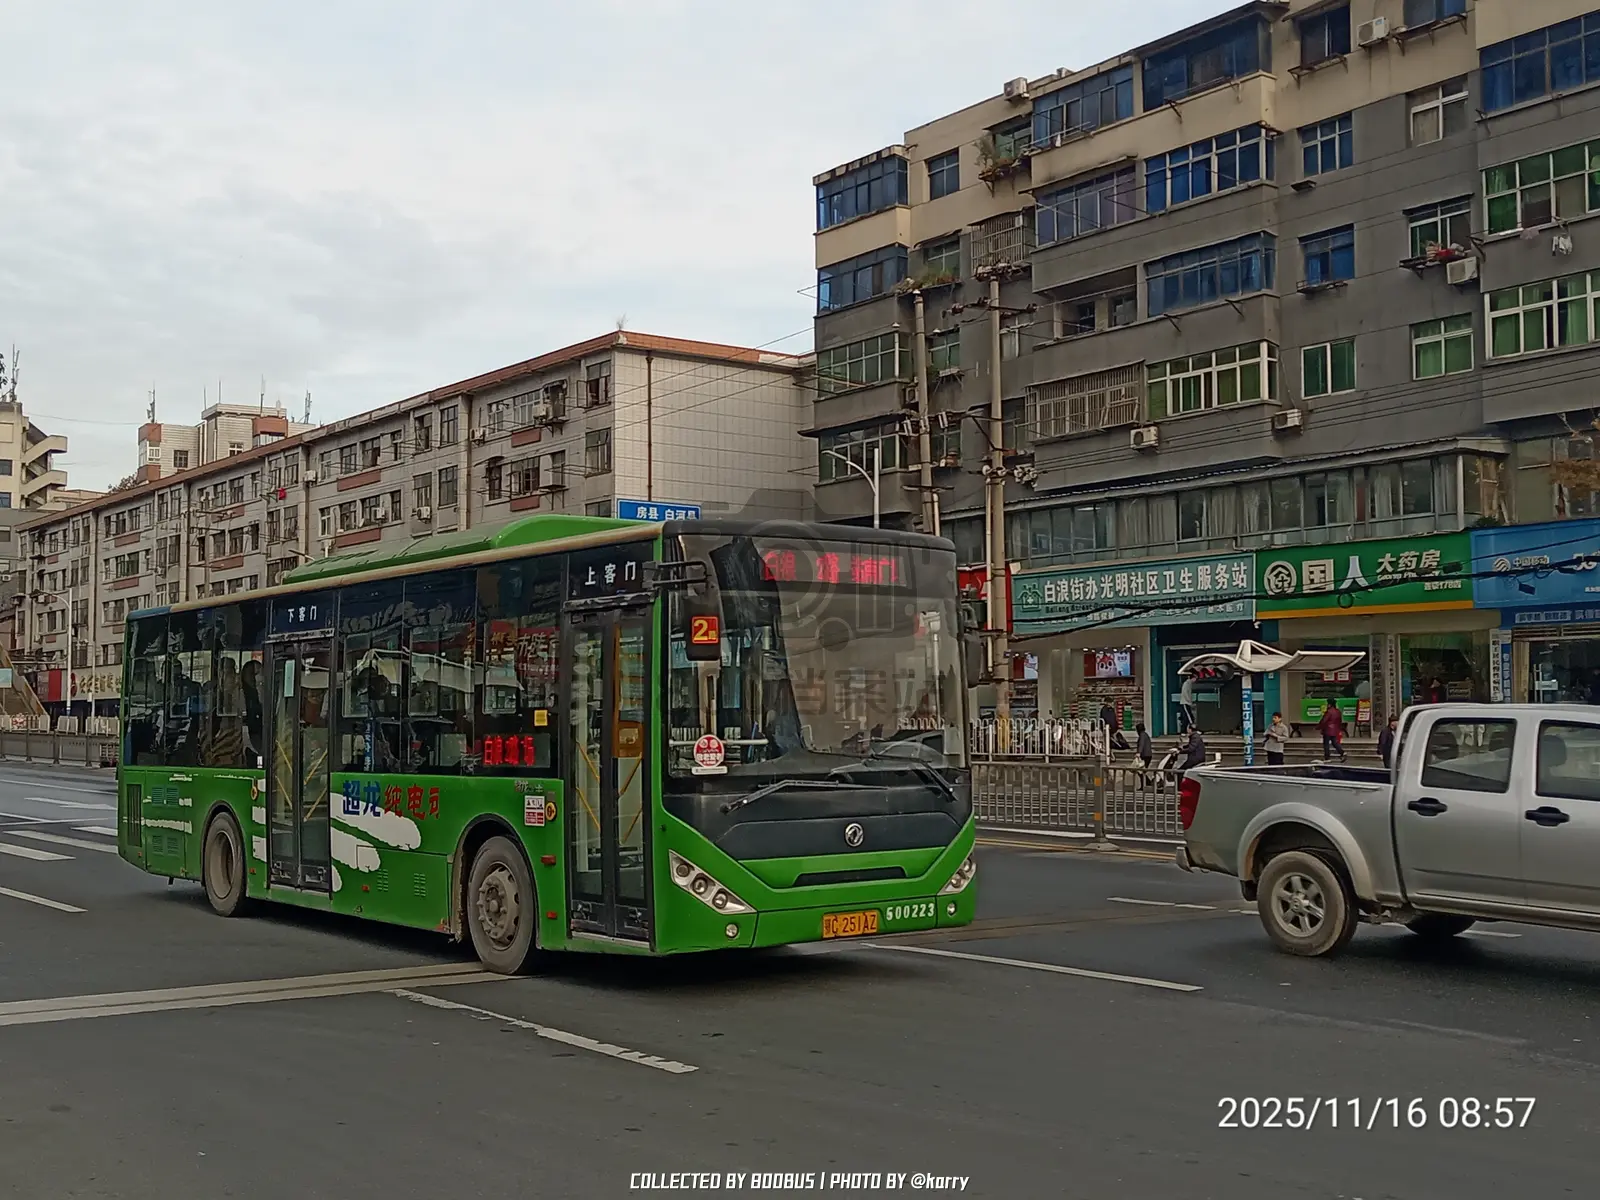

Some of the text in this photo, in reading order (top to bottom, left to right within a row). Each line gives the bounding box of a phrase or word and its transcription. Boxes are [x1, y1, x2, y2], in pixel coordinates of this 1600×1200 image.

[636, 506, 697, 521] 房县 白河县
[584, 560, 637, 586] 上客门
[1044, 561, 1248, 603] 白浪街办光明社区卫生服务站
[1302, 549, 1442, 593] 国人 大药房
[287, 605, 317, 623] 下客门
[886, 902, 935, 921] 500223
